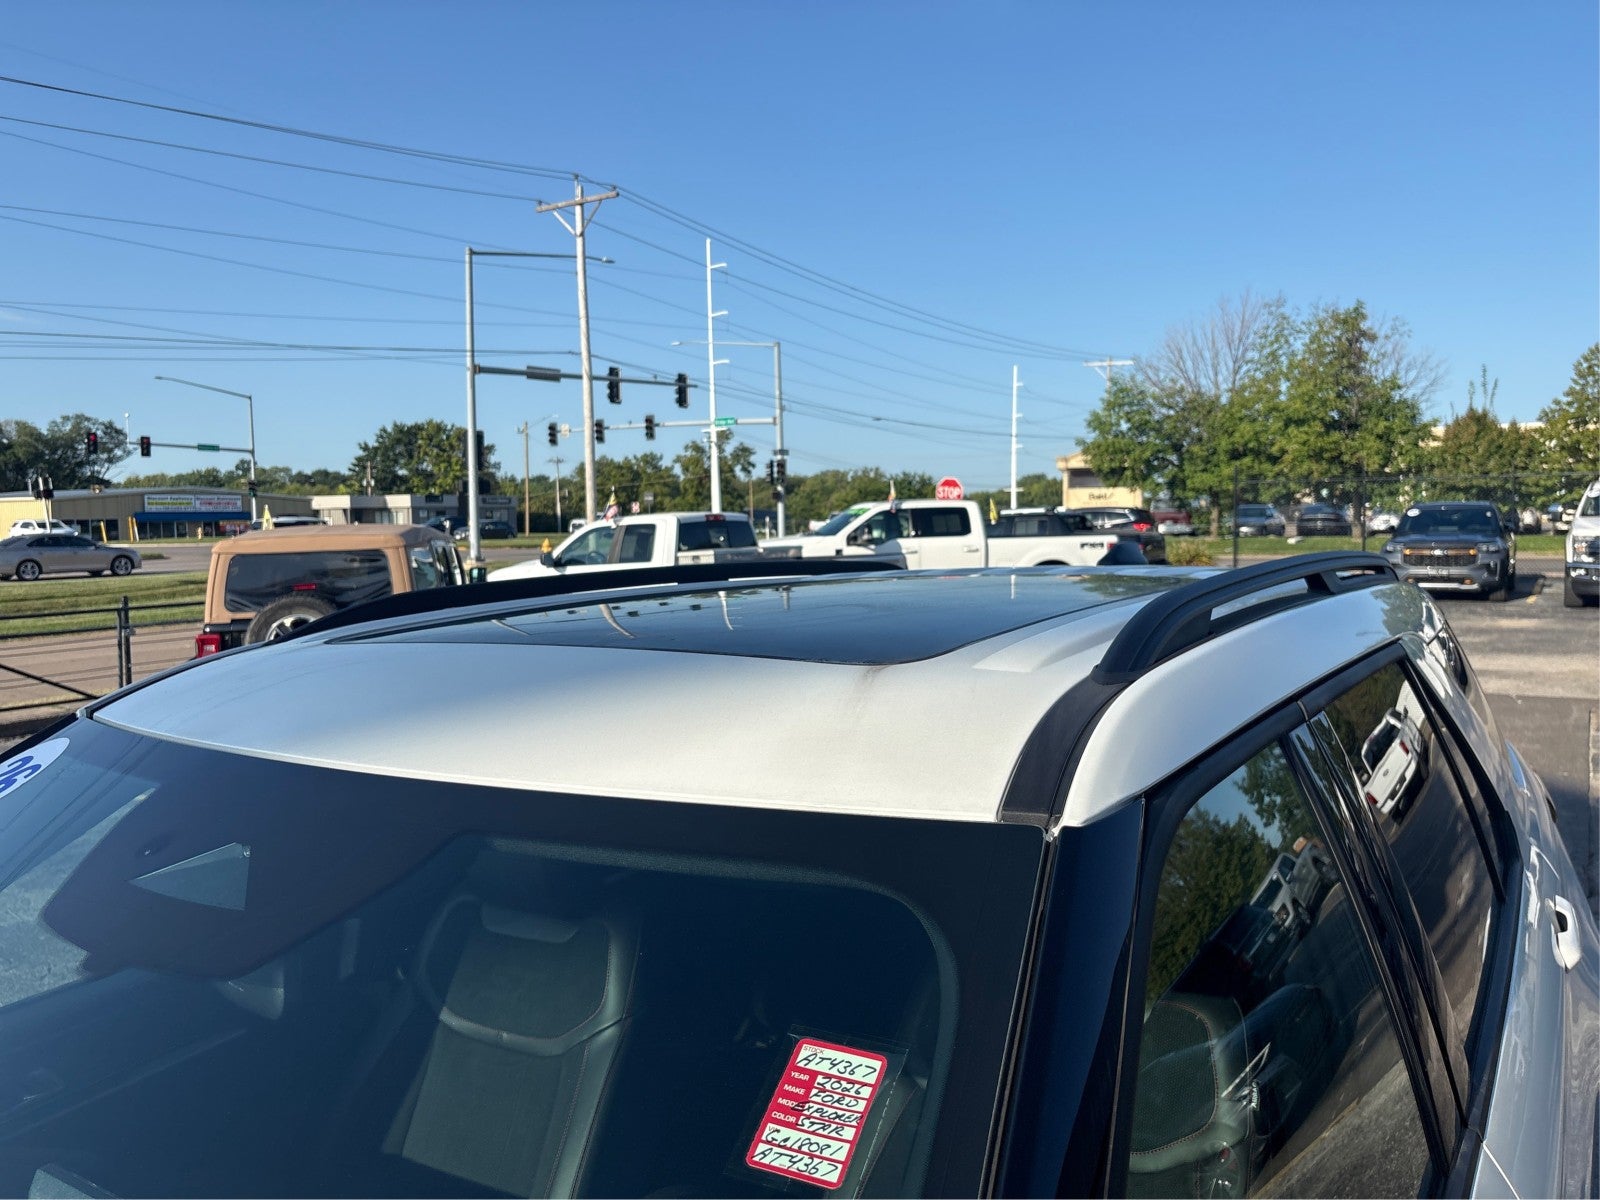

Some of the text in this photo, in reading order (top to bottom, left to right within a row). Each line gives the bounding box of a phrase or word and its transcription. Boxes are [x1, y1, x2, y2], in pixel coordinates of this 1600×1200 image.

[936, 486, 962, 500] STOP
[803, 1045, 825, 1055] STOCK
[796, 1053, 877, 1078] AT4367
[790, 1070, 810, 1081] YEAR
[783, 1084, 806, 1096] MAKE
[816, 1076, 867, 1095] 2026
[809, 1090, 859, 1108] FORD
[771, 1111, 797, 1123] COLOR
[796, 1117, 845, 1137] STAR
[751, 1147, 839, 1177] AT4367
